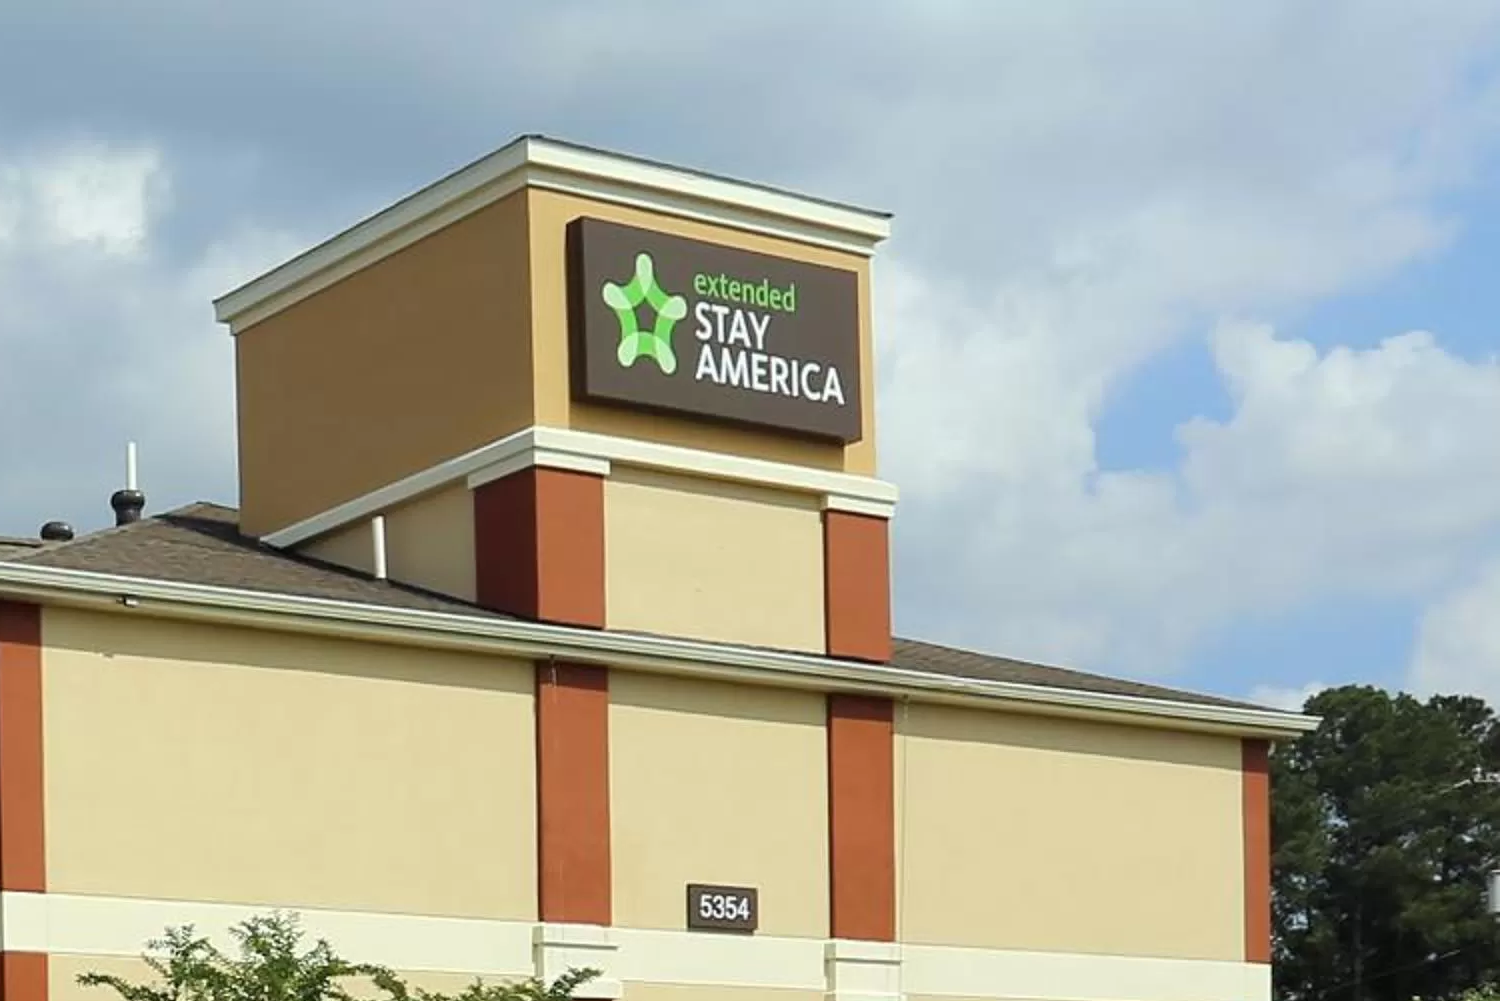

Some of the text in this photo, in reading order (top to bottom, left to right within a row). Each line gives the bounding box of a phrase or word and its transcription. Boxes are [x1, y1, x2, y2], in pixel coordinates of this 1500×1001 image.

[694, 273, 795, 312] extended
[695, 302, 770, 349] STAY
[695, 345, 845, 405] AMERICA
[700, 894, 750, 920] 5354
